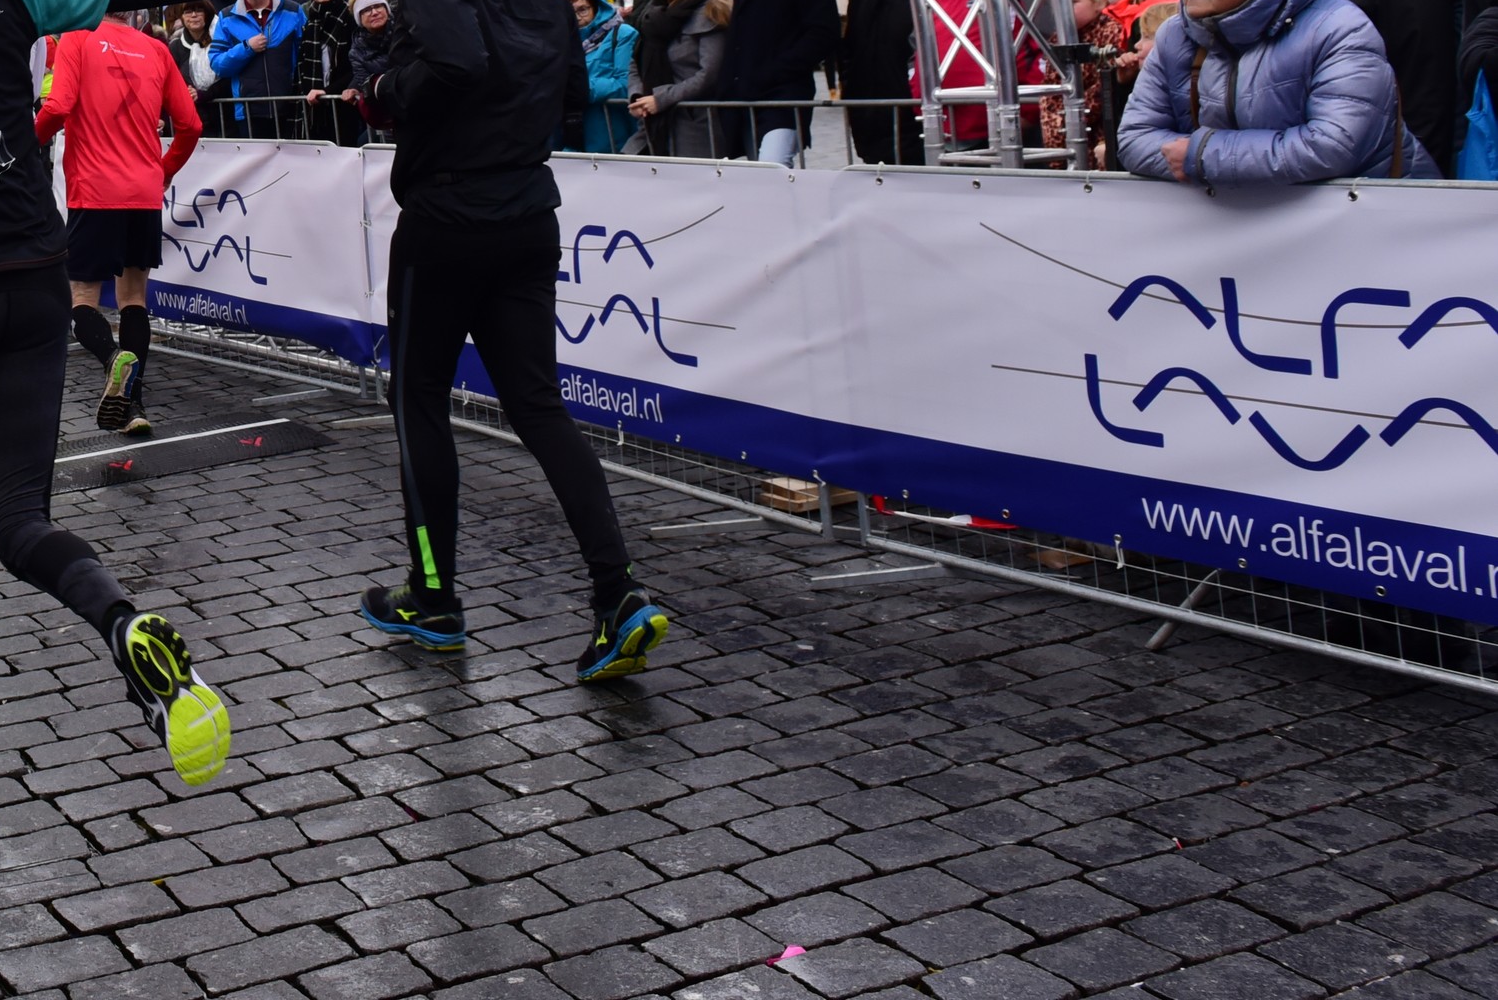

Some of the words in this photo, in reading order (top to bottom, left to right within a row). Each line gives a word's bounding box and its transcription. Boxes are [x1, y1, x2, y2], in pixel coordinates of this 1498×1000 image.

[163, 185, 248, 229] LFA
[155, 290, 250, 325] www.alfalaval.nl
[560, 373, 663, 424] alfalaval.nl
[1084, 353, 1498, 472] LAVA
[1142, 497, 1498, 599] www.alfalaval.
